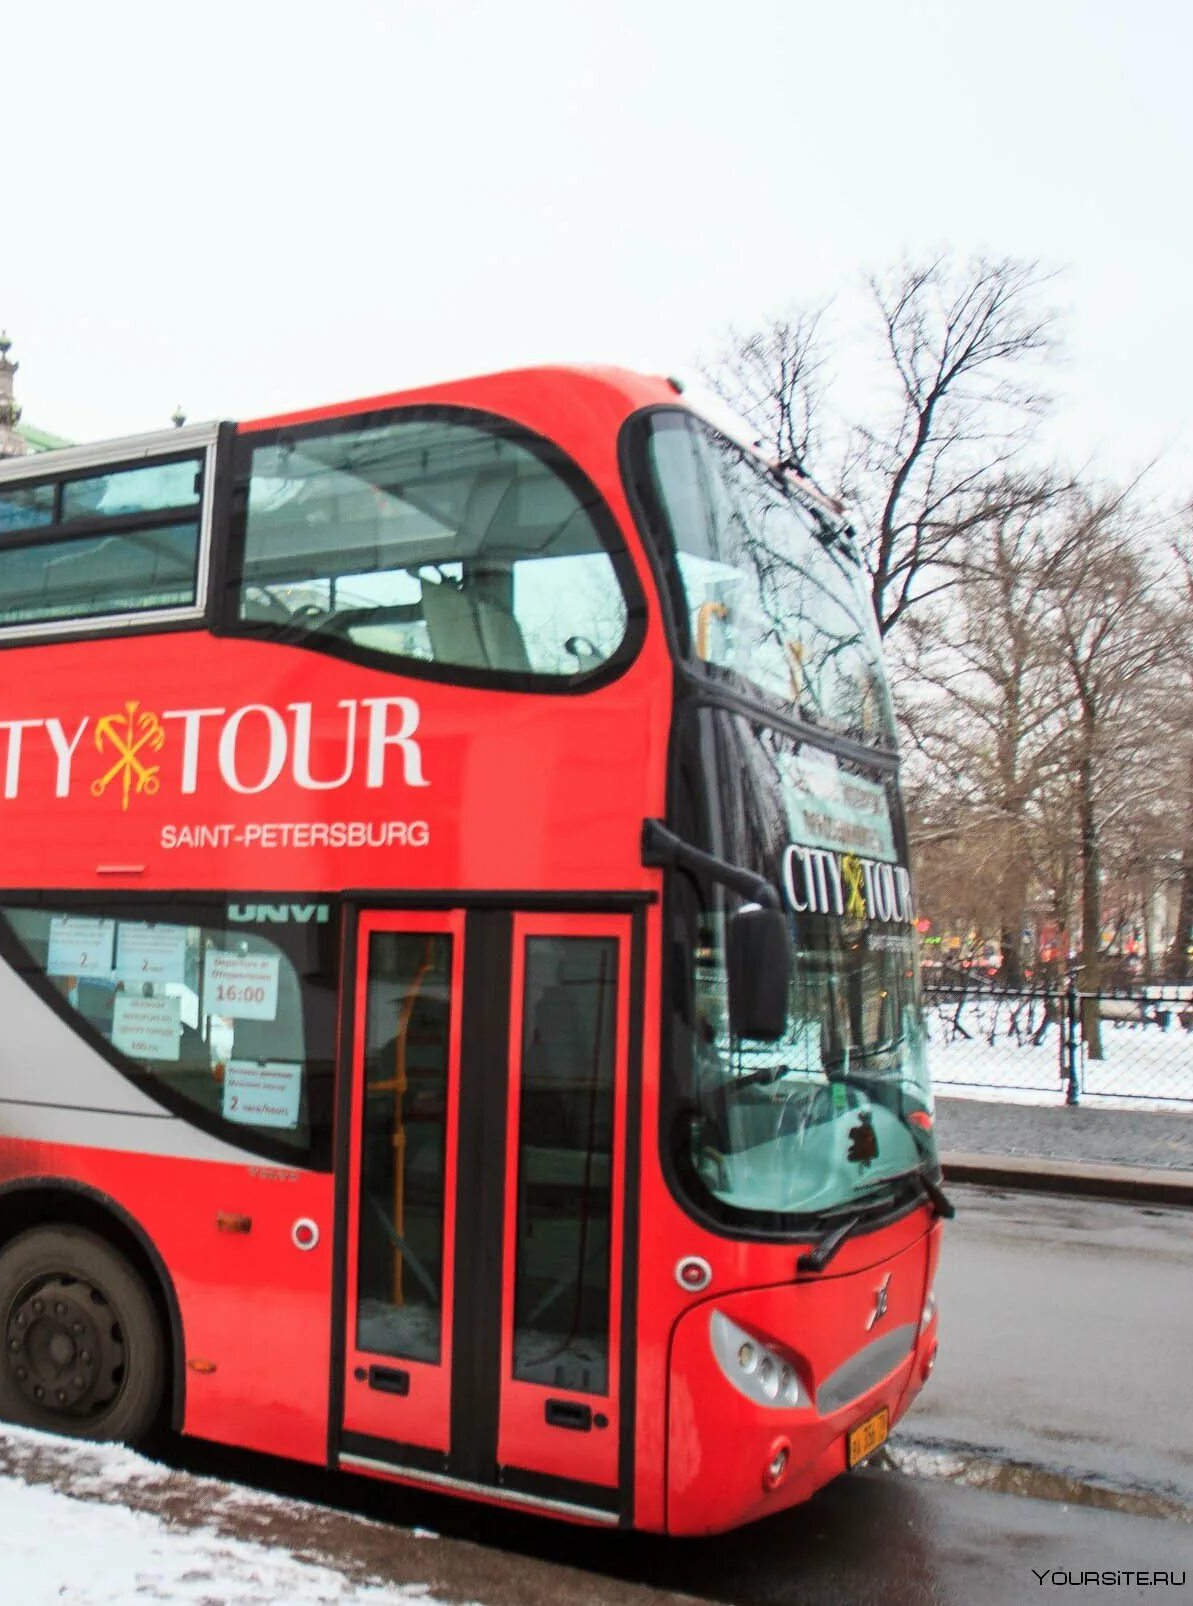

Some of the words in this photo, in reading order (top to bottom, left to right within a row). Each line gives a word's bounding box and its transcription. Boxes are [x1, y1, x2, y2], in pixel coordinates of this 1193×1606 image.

[162, 696, 432, 795] TOUR
[160, 821, 430, 849] SAINT-PETERSBURG
[782, 844, 845, 916] CITY
[858, 858, 914, 924] TOUR
[227, 903, 330, 923] UNVI
[216, 984, 265, 1003] 16:00
